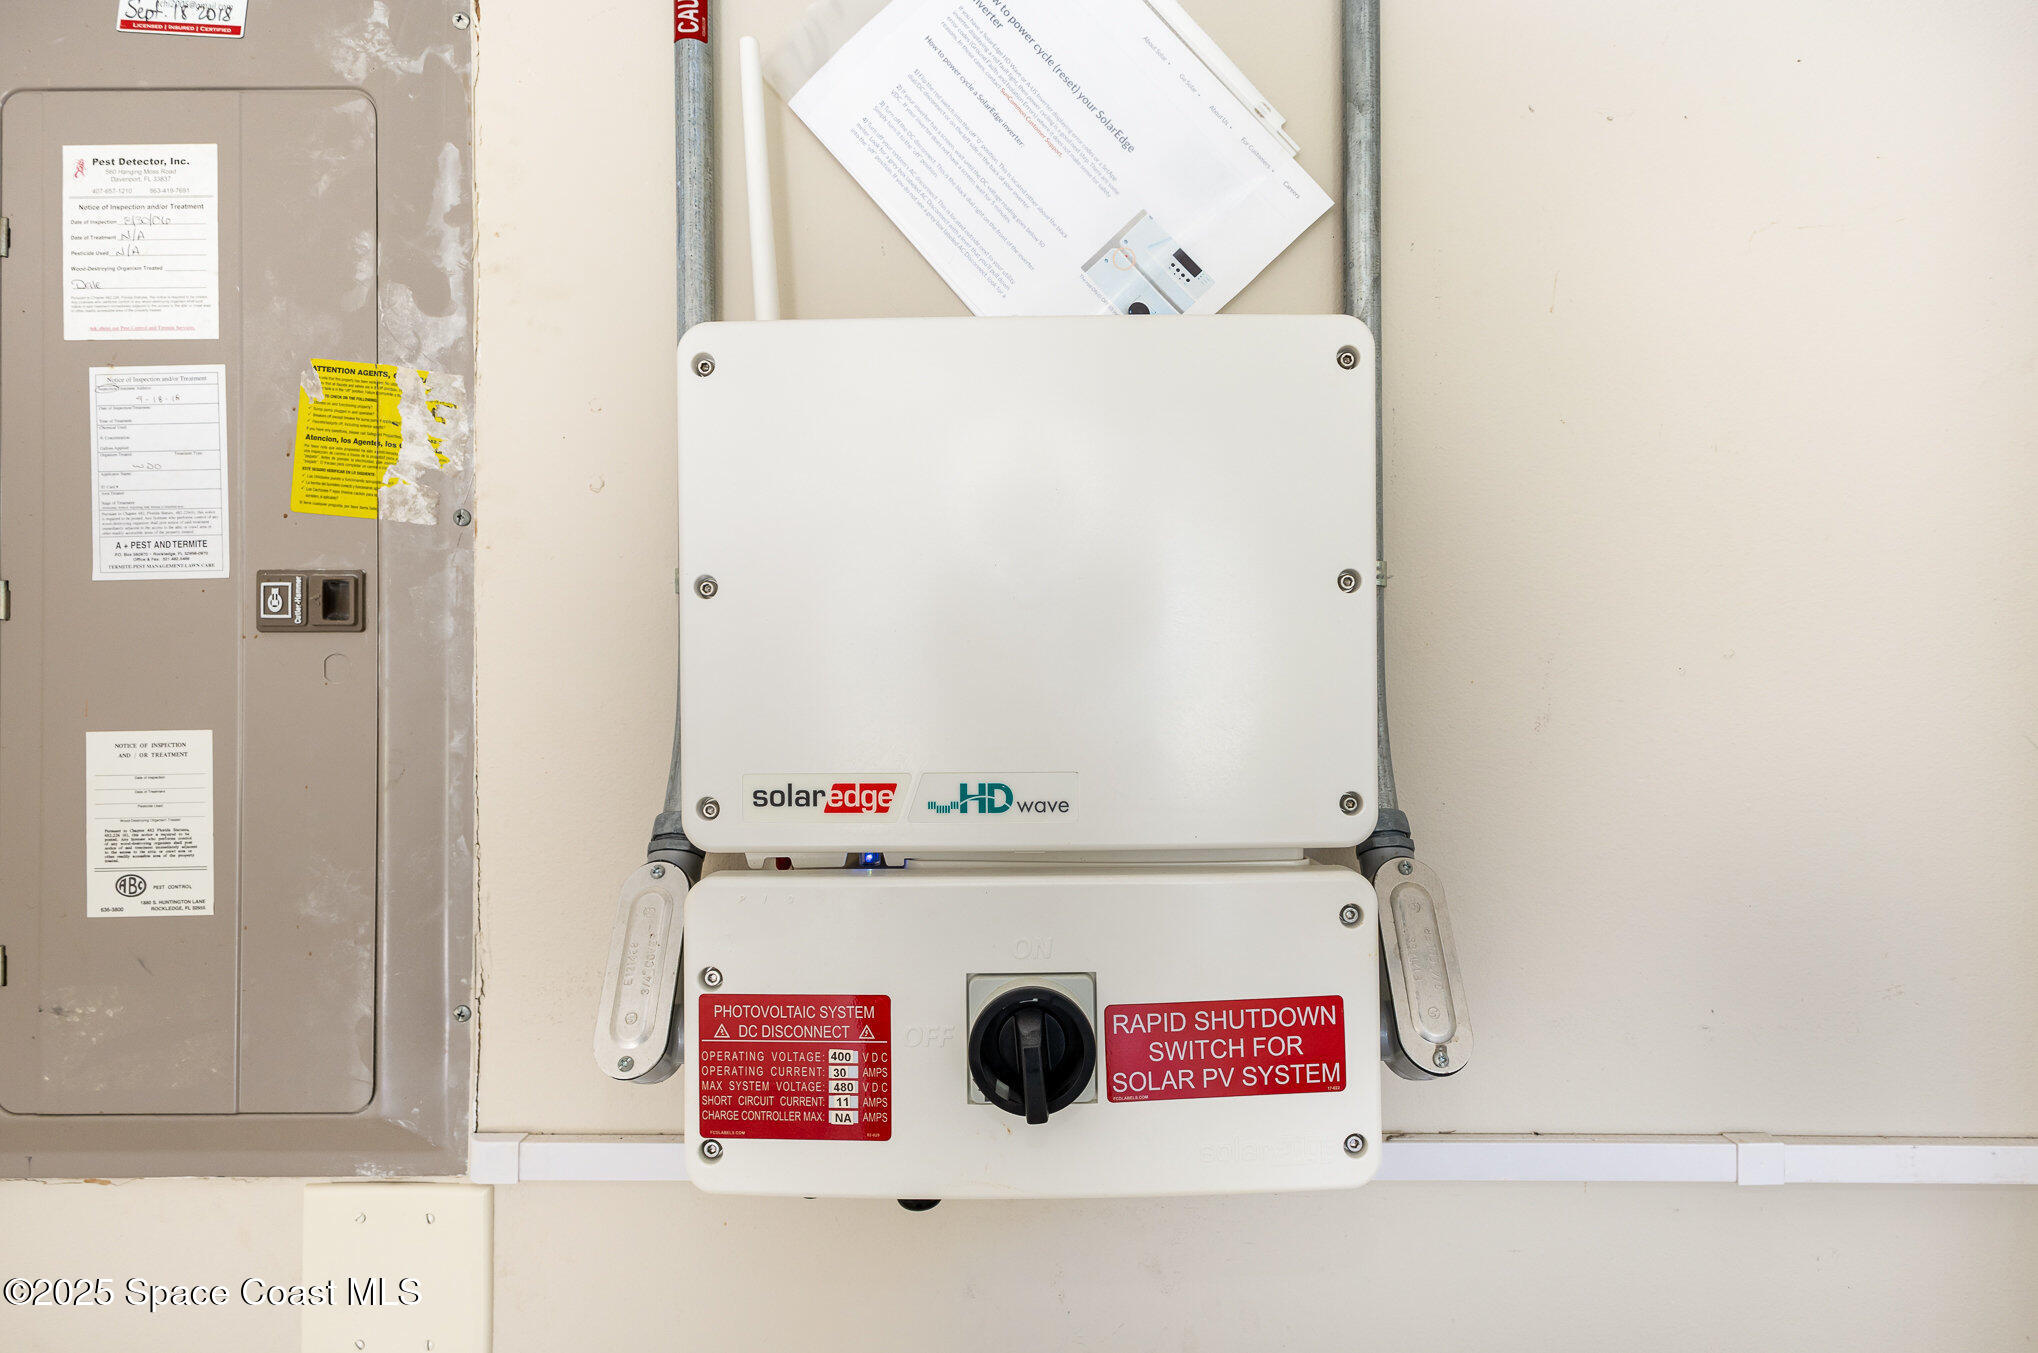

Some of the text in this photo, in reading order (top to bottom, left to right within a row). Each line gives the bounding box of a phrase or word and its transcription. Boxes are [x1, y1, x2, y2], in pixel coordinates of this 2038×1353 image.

[197, 5, 233, 22] 2018
[923, 34, 939, 51] How
[936, 49, 946, 58] to
[941, 56, 961, 77] power
[957, 73, 976, 92] cycle
[975, 92, 1005, 124] SolarEdge
[998, 3, 1136, 154] to power cycle (reset) your SolarEdge
[1239, 135, 1250, 146] For
[92, 158, 115, 166] Pest
[118, 158, 167, 166] Detector,
[313, 366, 356, 375] ATTENTION
[106, 376, 122, 384] Notice
[132, 375, 161, 384] Inspection
[305, 434, 339, 443] Atencion,
[130, 541, 152, 549] PEST
[153, 541, 171, 549] AND
[173, 540, 208, 548] TERMITE
[752, 782, 895, 814] solaredge
[958, 782, 1070, 814] HD wave
[118, 876, 143, 895] ABC
[1014, 937, 1054, 960] ON
[714, 1005, 876, 1019] PHOTOVOLTAIC SYSTEM
[1112, 1005, 1337, 1035] RAPID SHUTDOWN
[738, 1025, 851, 1039] DC DISCONNECT
[904, 1024, 955, 1048] OFF
[1148, 1035, 1304, 1062] SWITCH FOR
[701, 1051, 765, 1062] OPERATING
[770, 1052, 825, 1062] VOLTAGE:
[830, 1051, 852, 1062] 400
[701, 1066, 888, 1078] OPERATING CURRENT: 30 AMPS
[1112, 1062, 1341, 1093] SOLAR PV SYSTEM
[701, 1081, 723, 1091] MAX
[728, 1081, 770, 1091] SYSTEM
[776, 1081, 825, 1092] VOLTAGE:
[833, 1082, 854, 1092] 480
[701, 1095, 888, 1108] SHORT CIRCUIT CURRENT: 11 AMPS
[701, 1110, 888, 1123] CHARGE CONTROLLER MAX: NA AMPS
